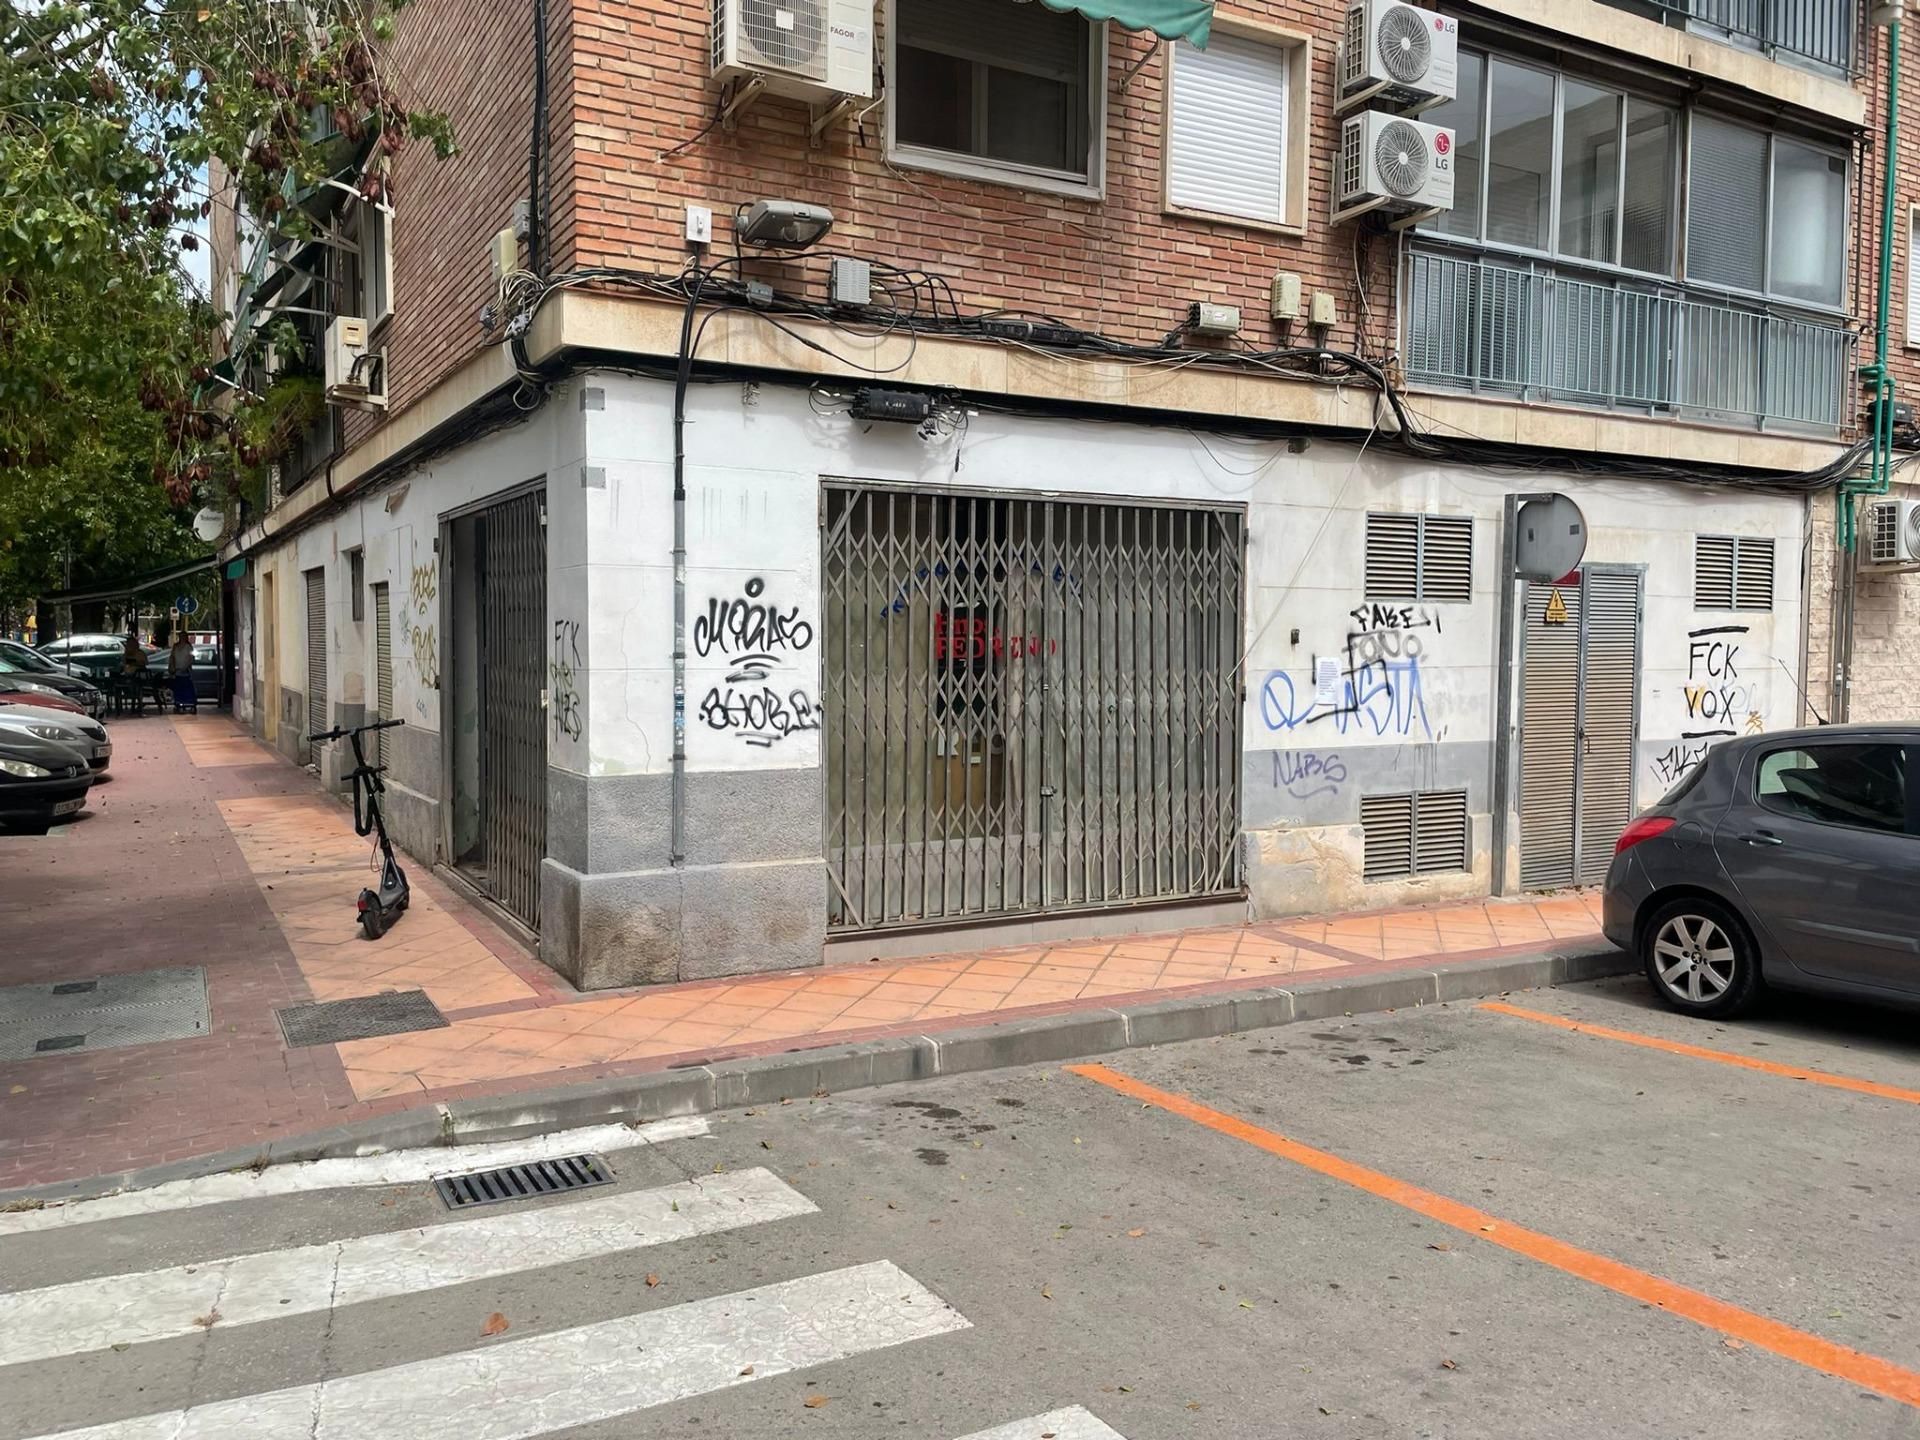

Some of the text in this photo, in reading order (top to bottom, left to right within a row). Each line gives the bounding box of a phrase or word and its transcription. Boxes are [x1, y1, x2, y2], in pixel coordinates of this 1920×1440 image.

[830, 26, 855, 40] FAGOR
[1444, 22, 1455, 34] LG
[1435, 156, 1449, 170] LG
[554, 619, 582, 679] FCK
[1688, 641, 1739, 680] FCK
[1684, 686, 1736, 726] VOX
